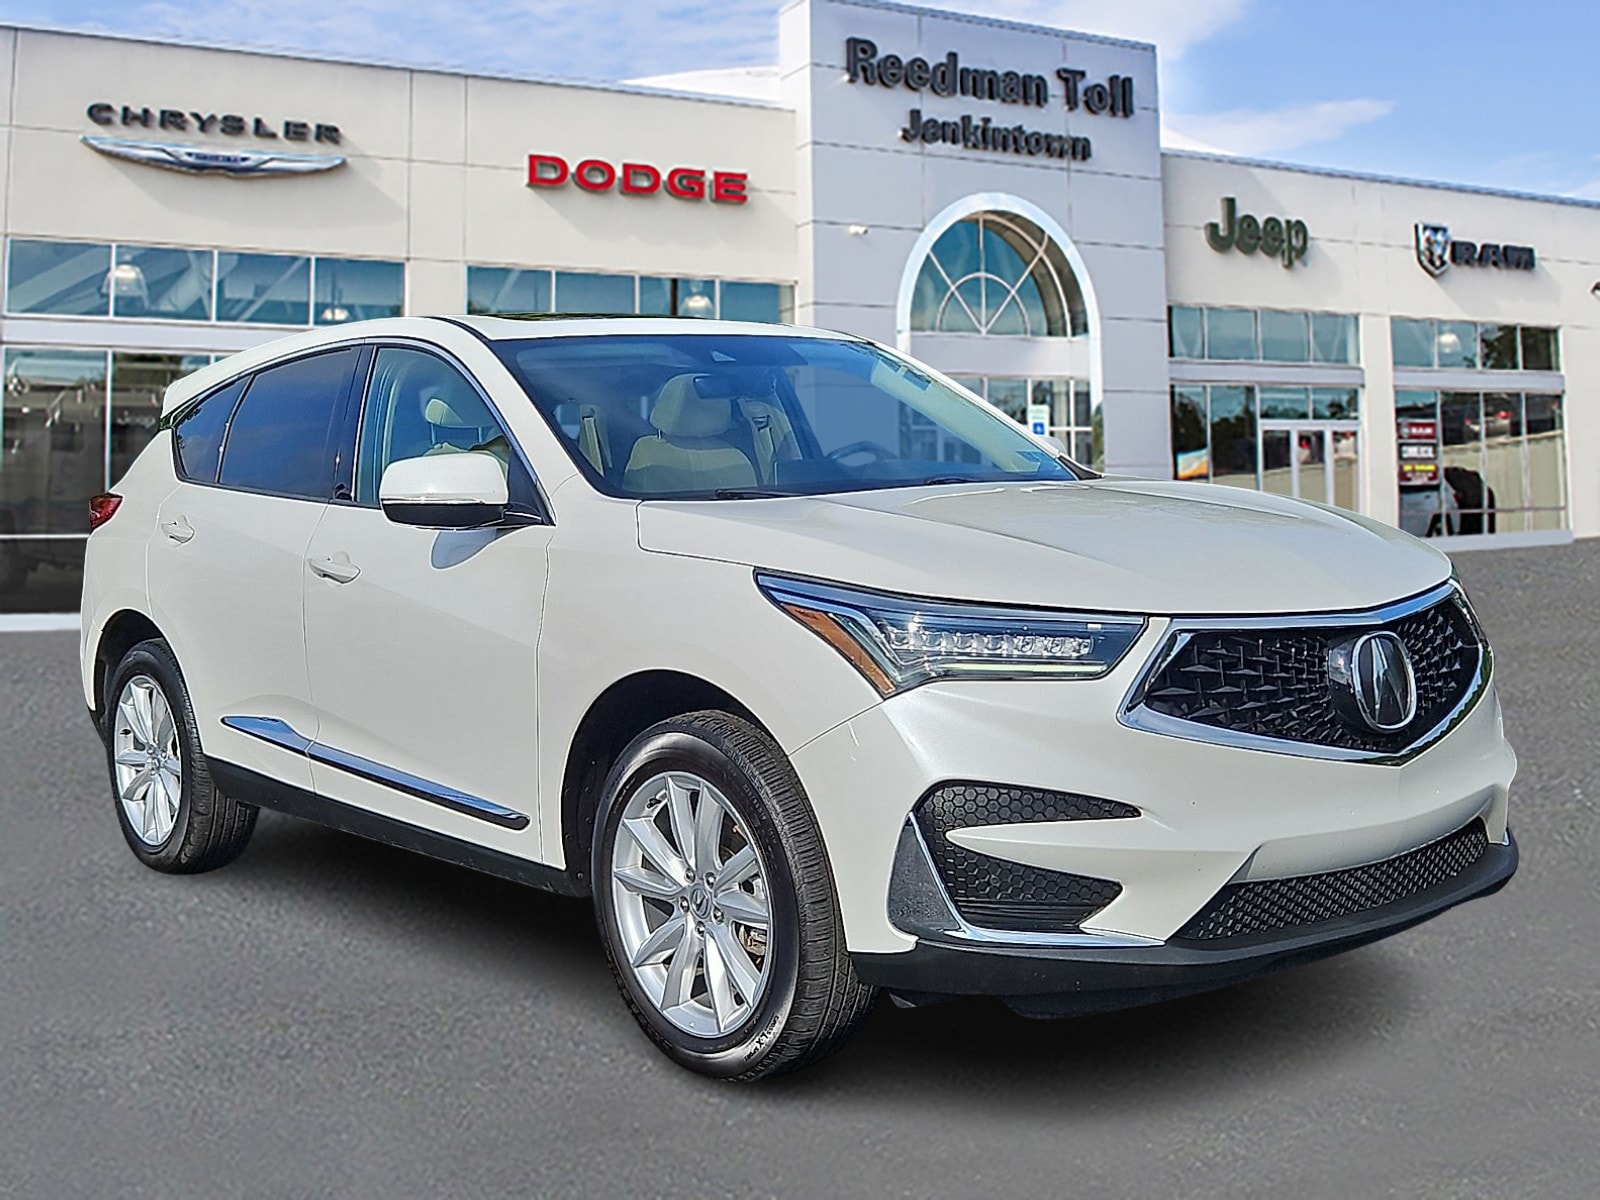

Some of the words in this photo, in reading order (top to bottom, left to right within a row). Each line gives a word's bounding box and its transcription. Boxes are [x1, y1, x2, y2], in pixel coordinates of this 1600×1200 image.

[845, 36, 1048, 107] Reedman
[1056, 67, 1133, 118] Toll
[86, 102, 341, 145] CHRYSLER
[902, 108, 1091, 161] Jenkintown
[527, 153, 748, 204] DODGE
[1205, 196, 1308, 269] Jeep
[1450, 240, 1535, 270] RAM
